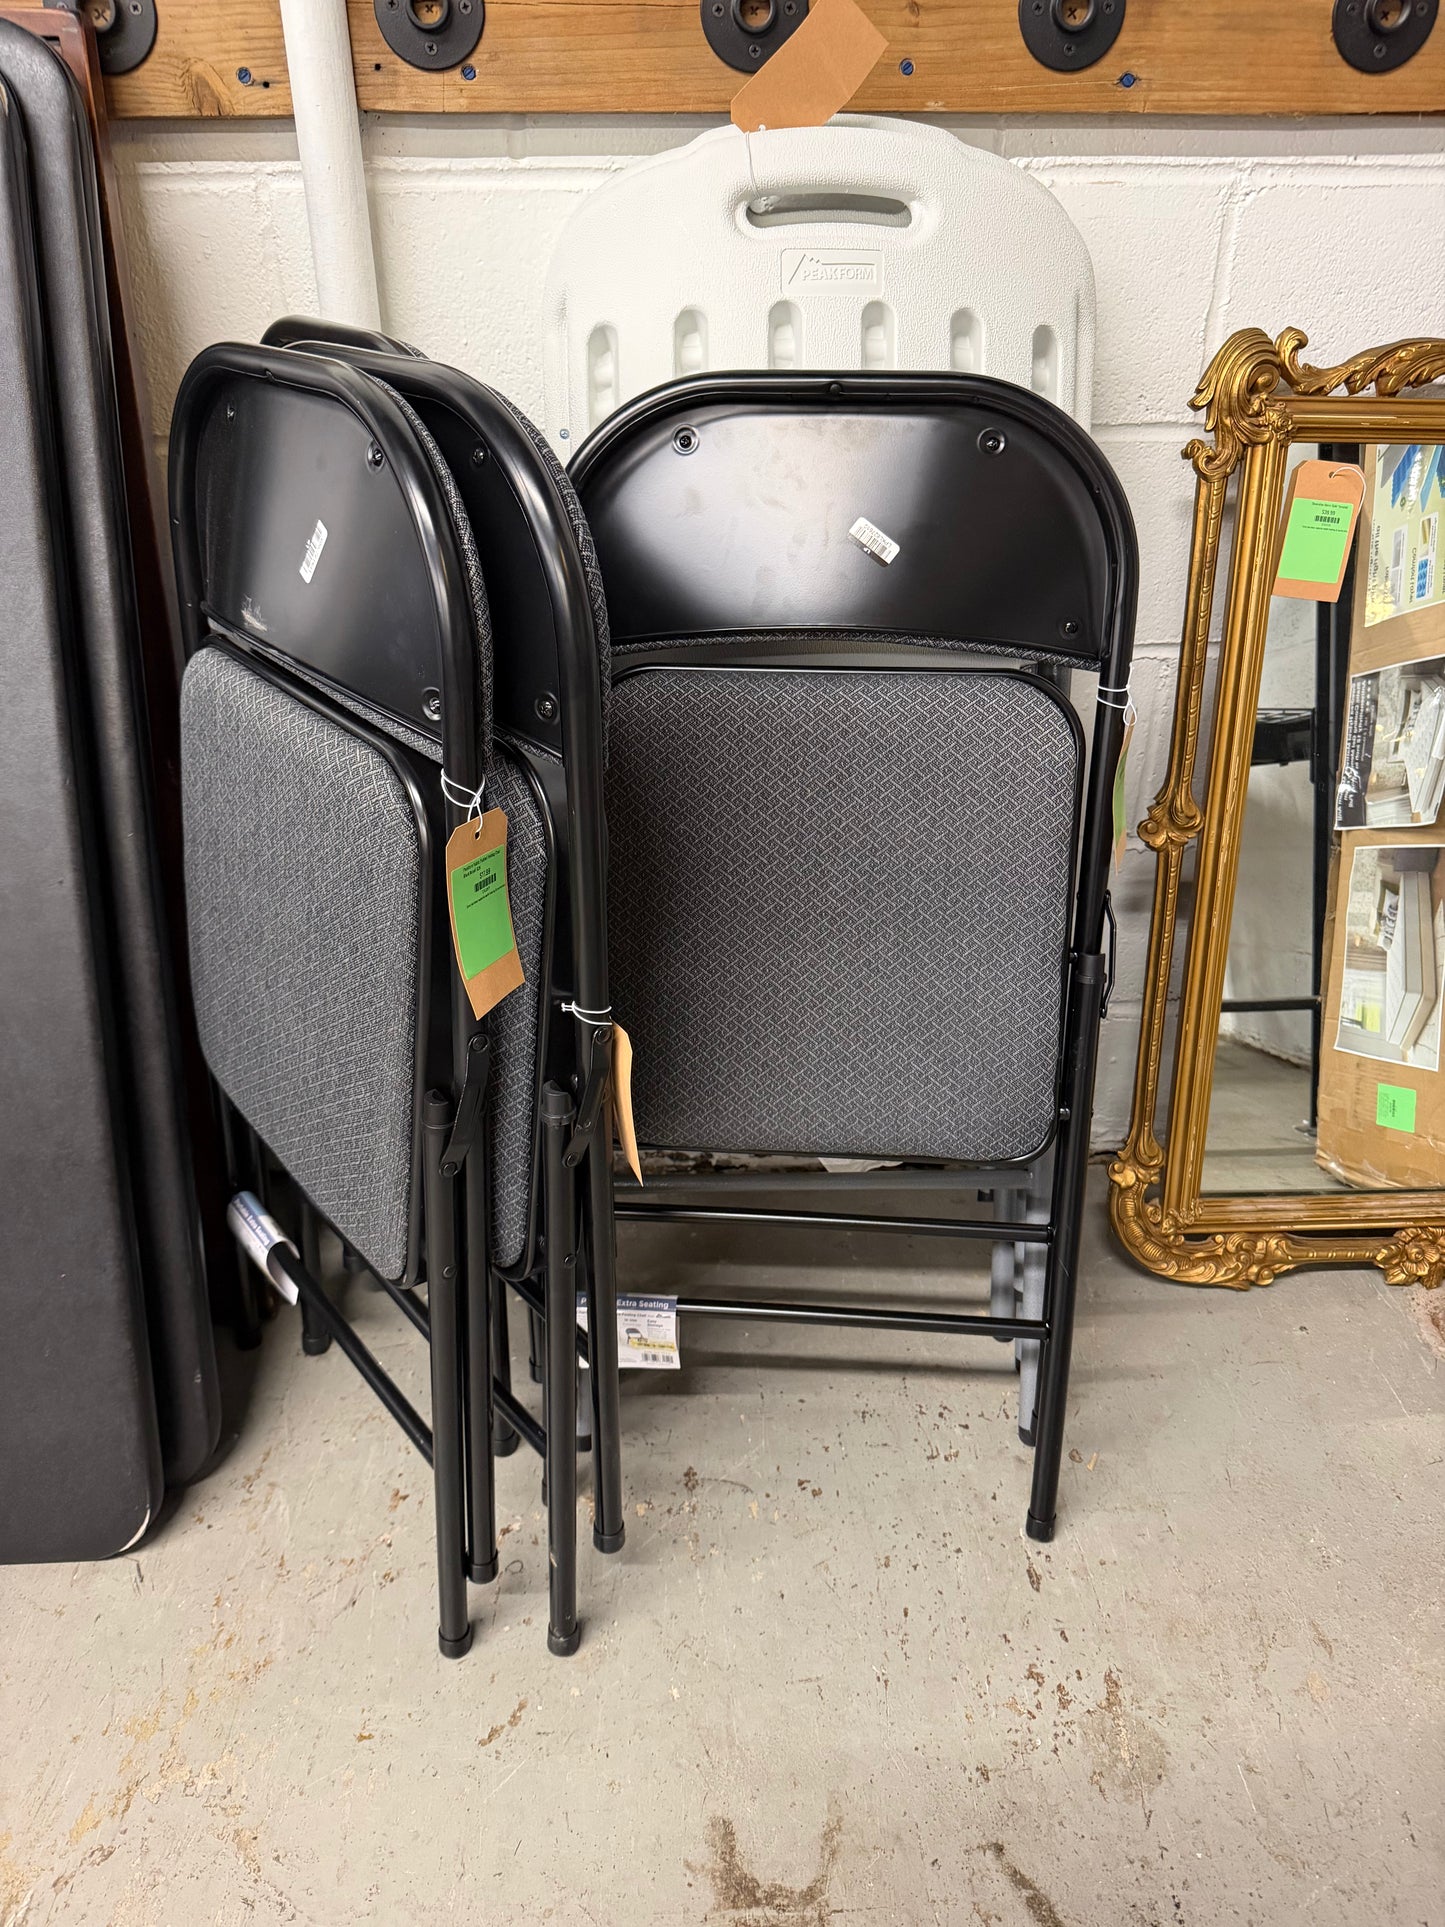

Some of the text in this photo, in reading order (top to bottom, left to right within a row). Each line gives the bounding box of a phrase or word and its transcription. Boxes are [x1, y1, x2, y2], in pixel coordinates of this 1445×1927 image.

[802, 267, 874, 281] PEAKFORM
[617, 1299, 669, 1310] Extra Seating
